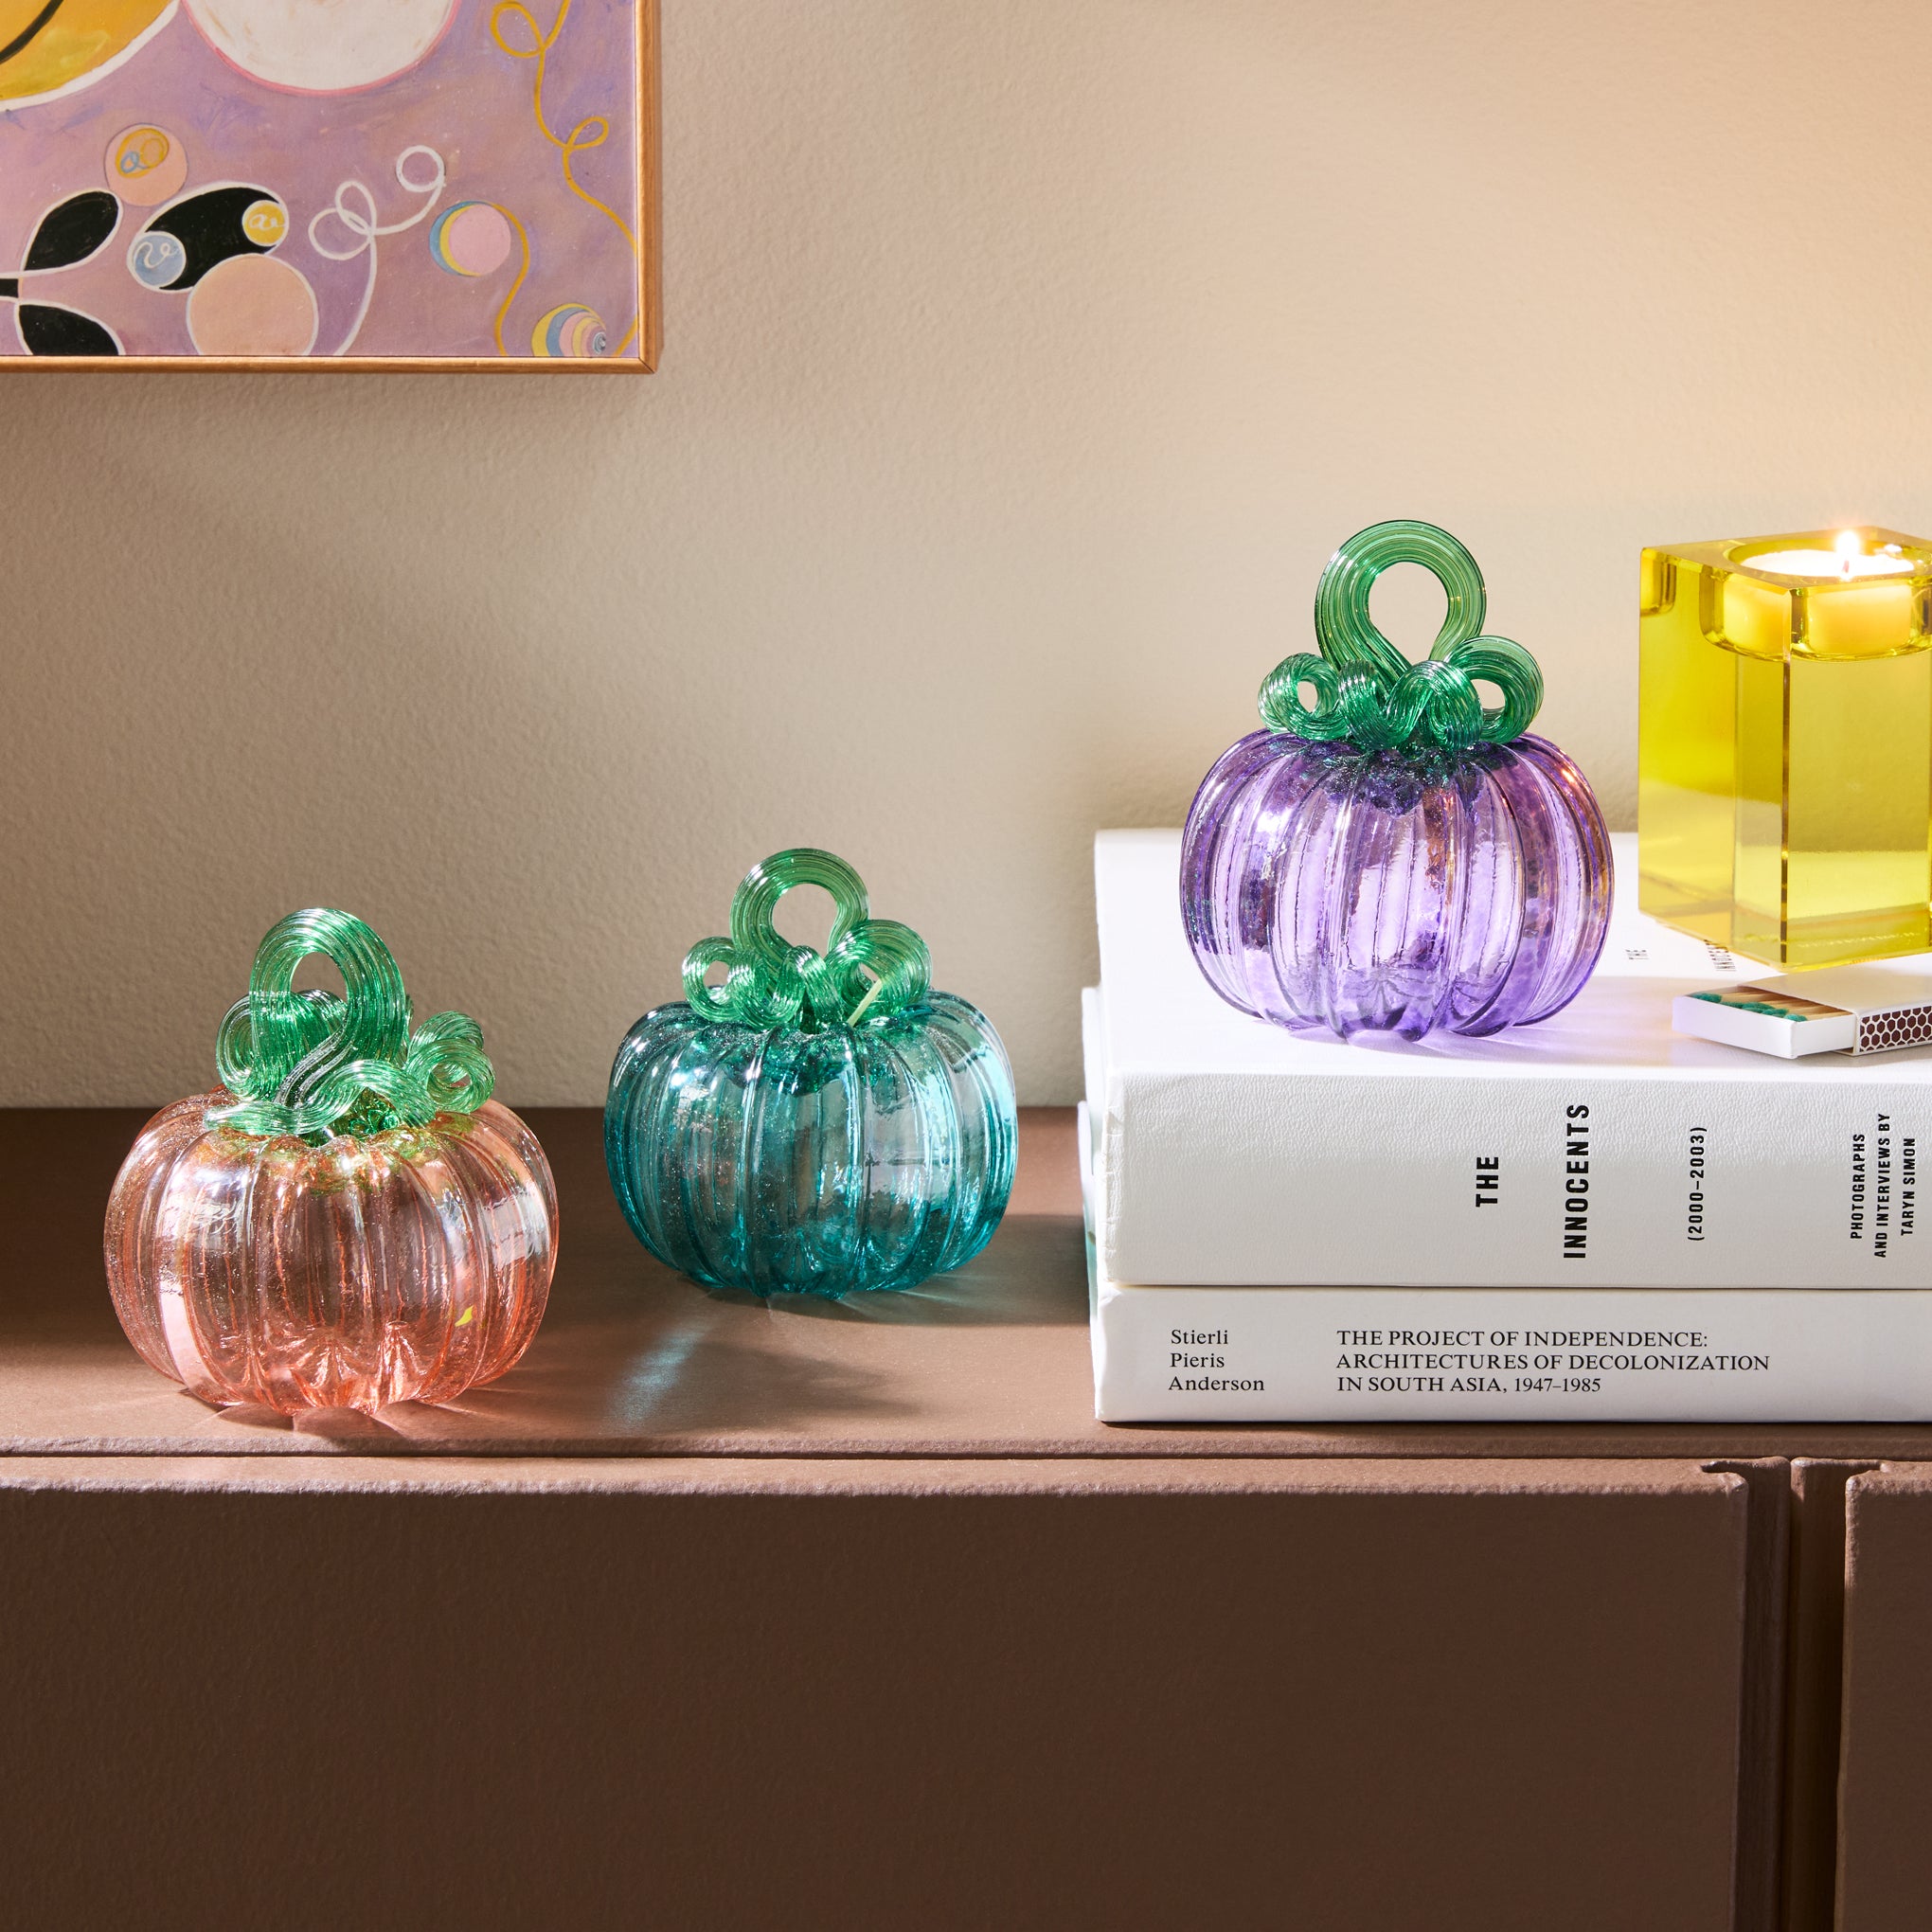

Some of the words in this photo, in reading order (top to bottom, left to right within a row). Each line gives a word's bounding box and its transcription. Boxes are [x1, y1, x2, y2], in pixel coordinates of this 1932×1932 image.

[1877, 1113, 1891, 1132] BY
[1902, 1137, 1917, 1186] SIMON
[1475, 1156, 1499, 1208] THE
[1563, 1104, 1590, 1259] INNOCENTS
[1850, 1134, 1866, 1240] PHOTOGRAPHS
[1875, 1137, 1891, 1227] INTERVIEWS
[1900, 1190, 1916, 1237] TARYN
[1873, 1232, 1888, 1259] AND
[1171, 1329, 1228, 1345] Stierli
[1336, 1330, 1384, 1346] THE
[1387, 1330, 1485, 1347] PROJECT
[1490, 1331, 1519, 1347] OF
[1524, 1331, 1708, 1348] INDEPENDENCE:
[1170, 1352, 1225, 1368] Pieris
[1335, 1353, 1529, 1370] ARCHITECTURES
[1533, 1354, 1564, 1370] OF
[1568, 1354, 1770, 1371] DECOLONIZATION
[1168, 1375, 1265, 1391] Anderson
[1337, 1376, 1363, 1391] IN
[1368, 1376, 1444, 1392] SOUTH
[1449, 1377, 1508, 1394] ASIA,
